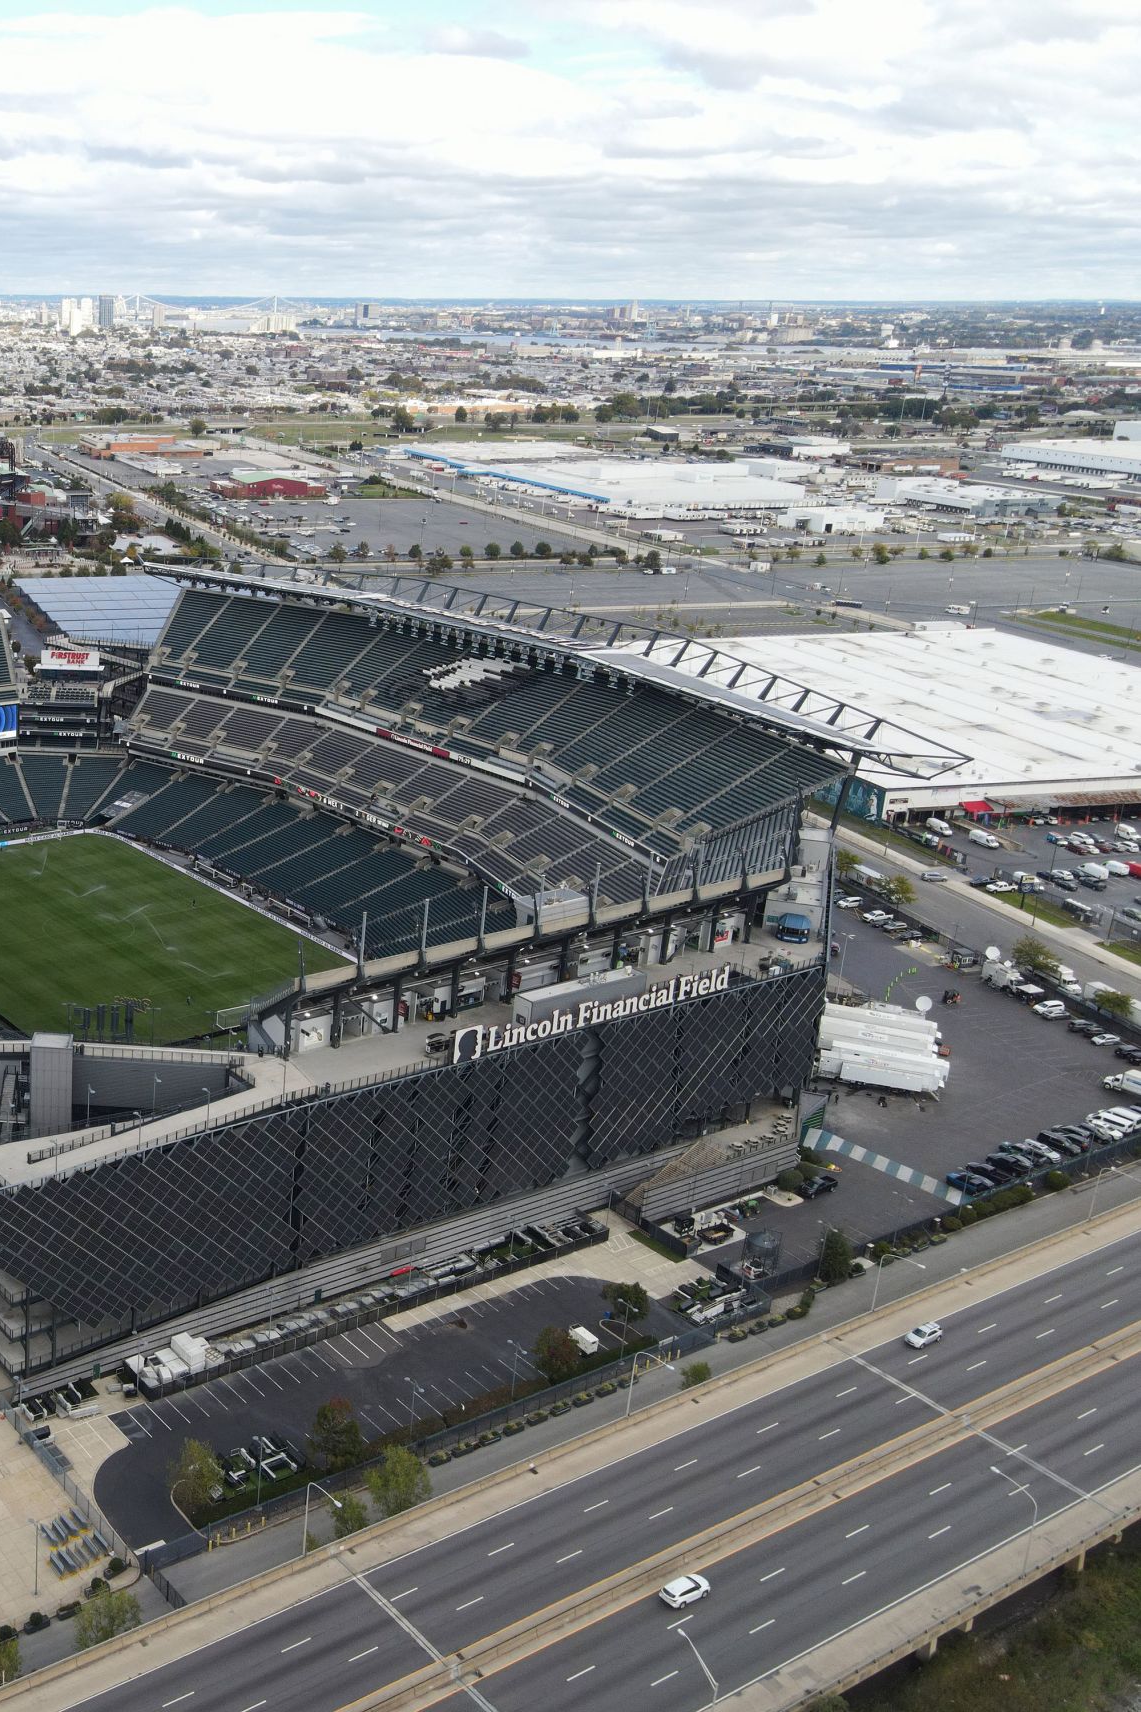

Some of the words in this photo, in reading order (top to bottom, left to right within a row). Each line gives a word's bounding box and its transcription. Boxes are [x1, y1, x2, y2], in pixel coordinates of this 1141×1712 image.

[486, 1009, 573, 1052] Lincoln
[576, 979, 676, 1028] Financial
[677, 965, 730, 1001] Field
